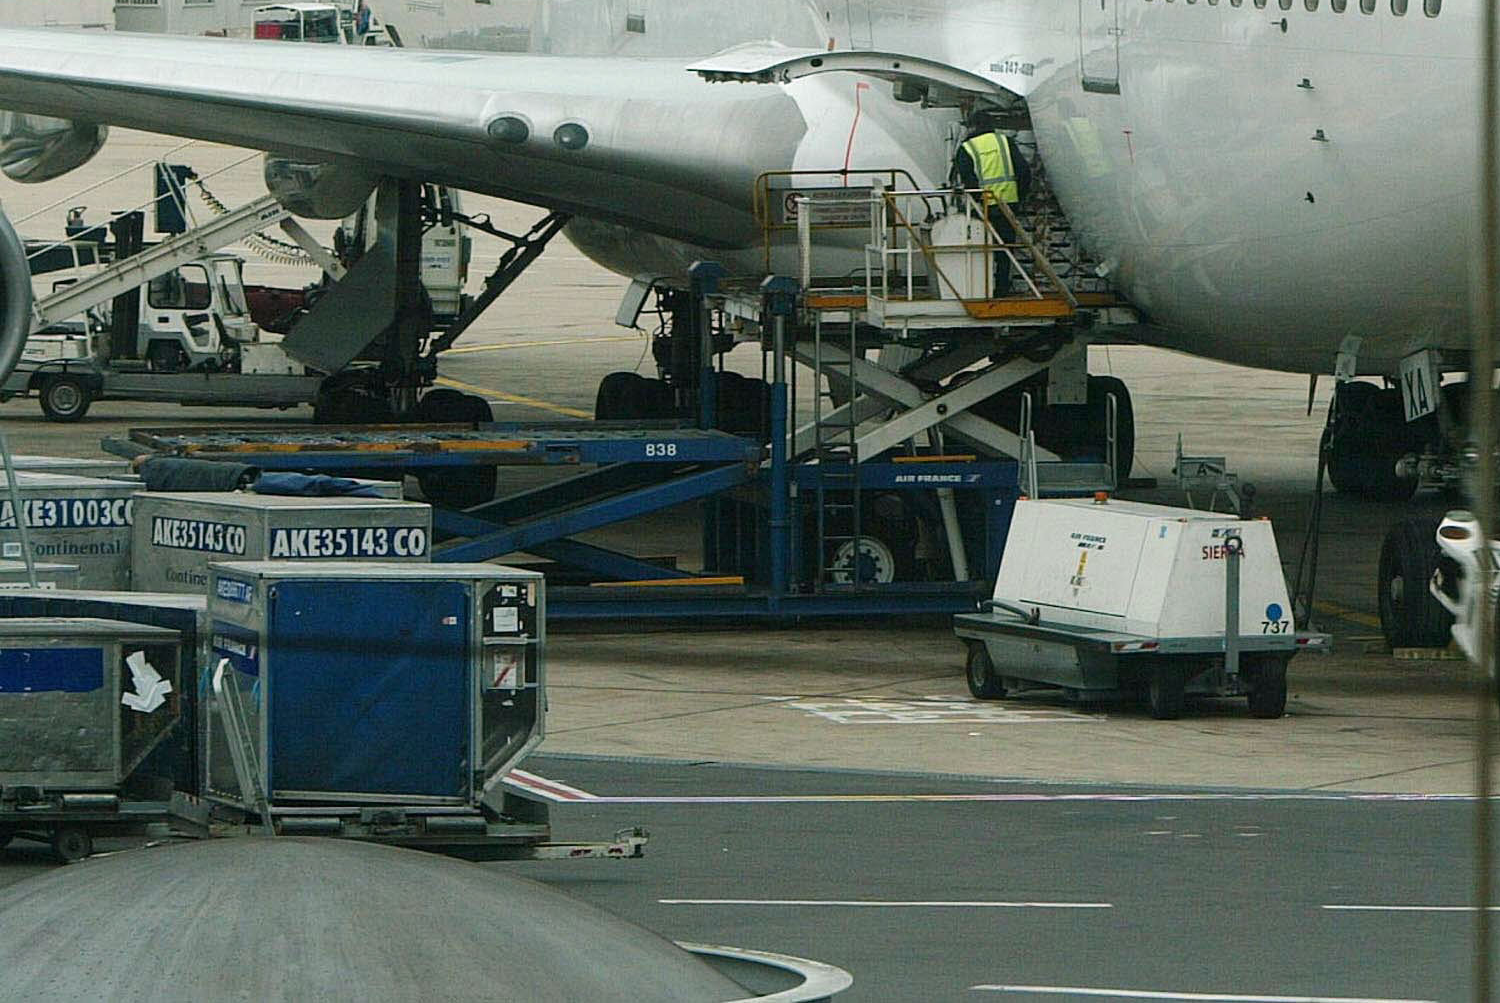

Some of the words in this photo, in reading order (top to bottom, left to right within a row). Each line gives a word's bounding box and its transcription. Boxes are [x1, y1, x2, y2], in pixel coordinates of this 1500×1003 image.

[1404, 367, 1430, 417] XA
[645, 443, 677, 457] 838
[917, 475, 961, 483] FRANCE
[29, 539, 120, 556] ontinental
[1202, 545, 1245, 559] SIERA
[1261, 621, 1290, 634] 737
